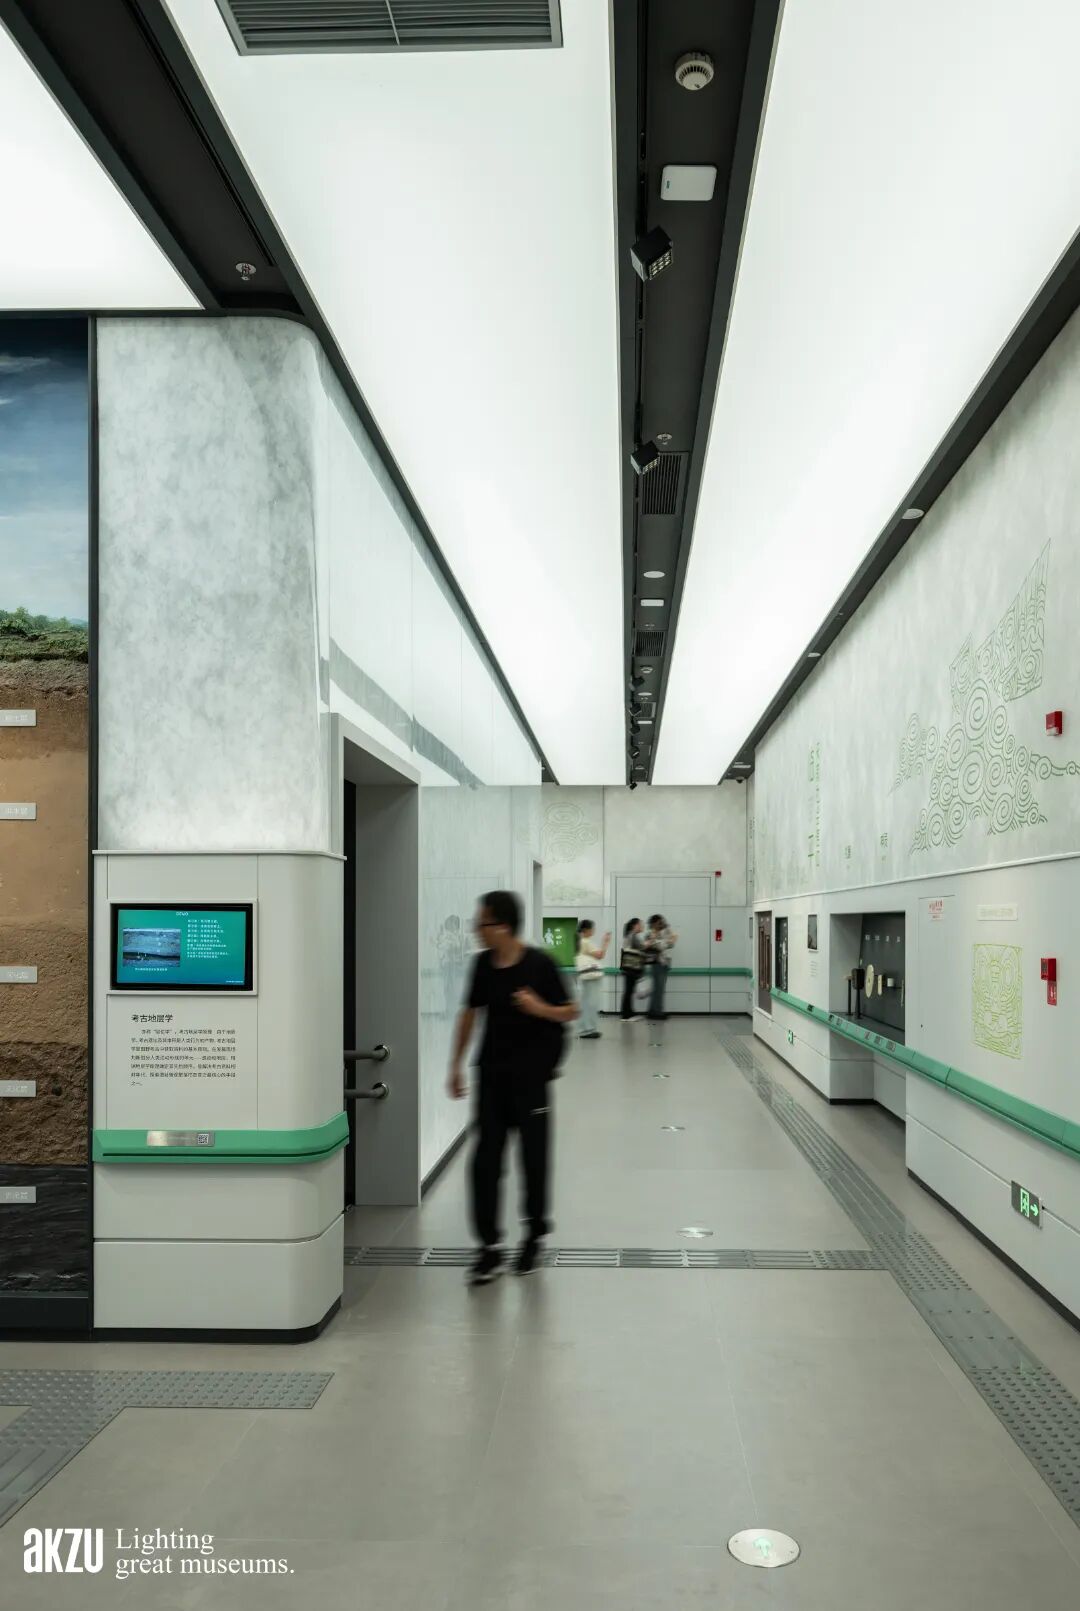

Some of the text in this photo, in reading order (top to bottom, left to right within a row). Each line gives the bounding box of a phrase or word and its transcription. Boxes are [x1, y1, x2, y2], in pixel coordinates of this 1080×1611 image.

[131, 1014, 174, 1023] 考古地层学
